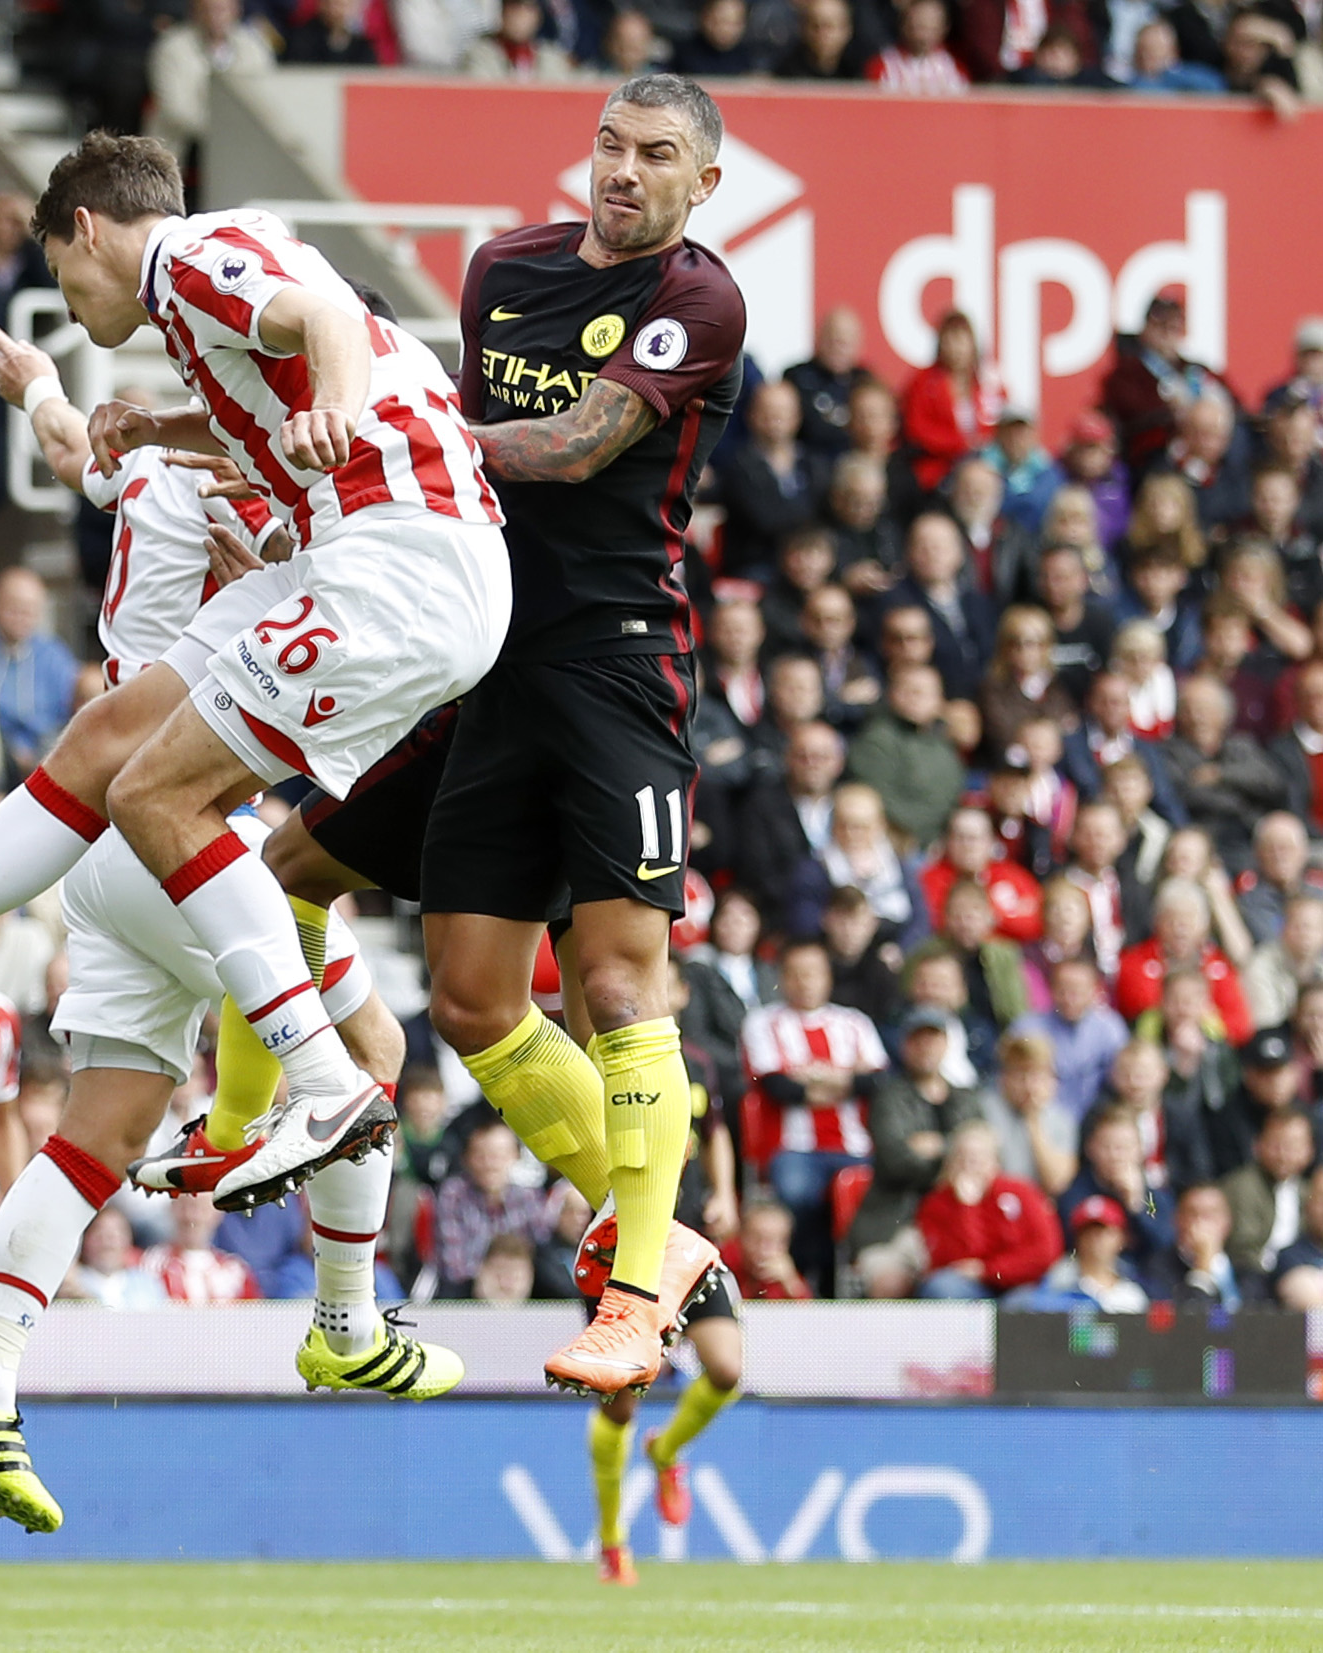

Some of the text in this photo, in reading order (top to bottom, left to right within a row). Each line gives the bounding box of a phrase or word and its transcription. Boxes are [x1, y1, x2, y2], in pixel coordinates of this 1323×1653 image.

[878, 182, 1227, 418] dpd
[236, 639, 281, 700] macron
[254, 594, 340, 675] 26
[635, 785, 683, 864] 11
